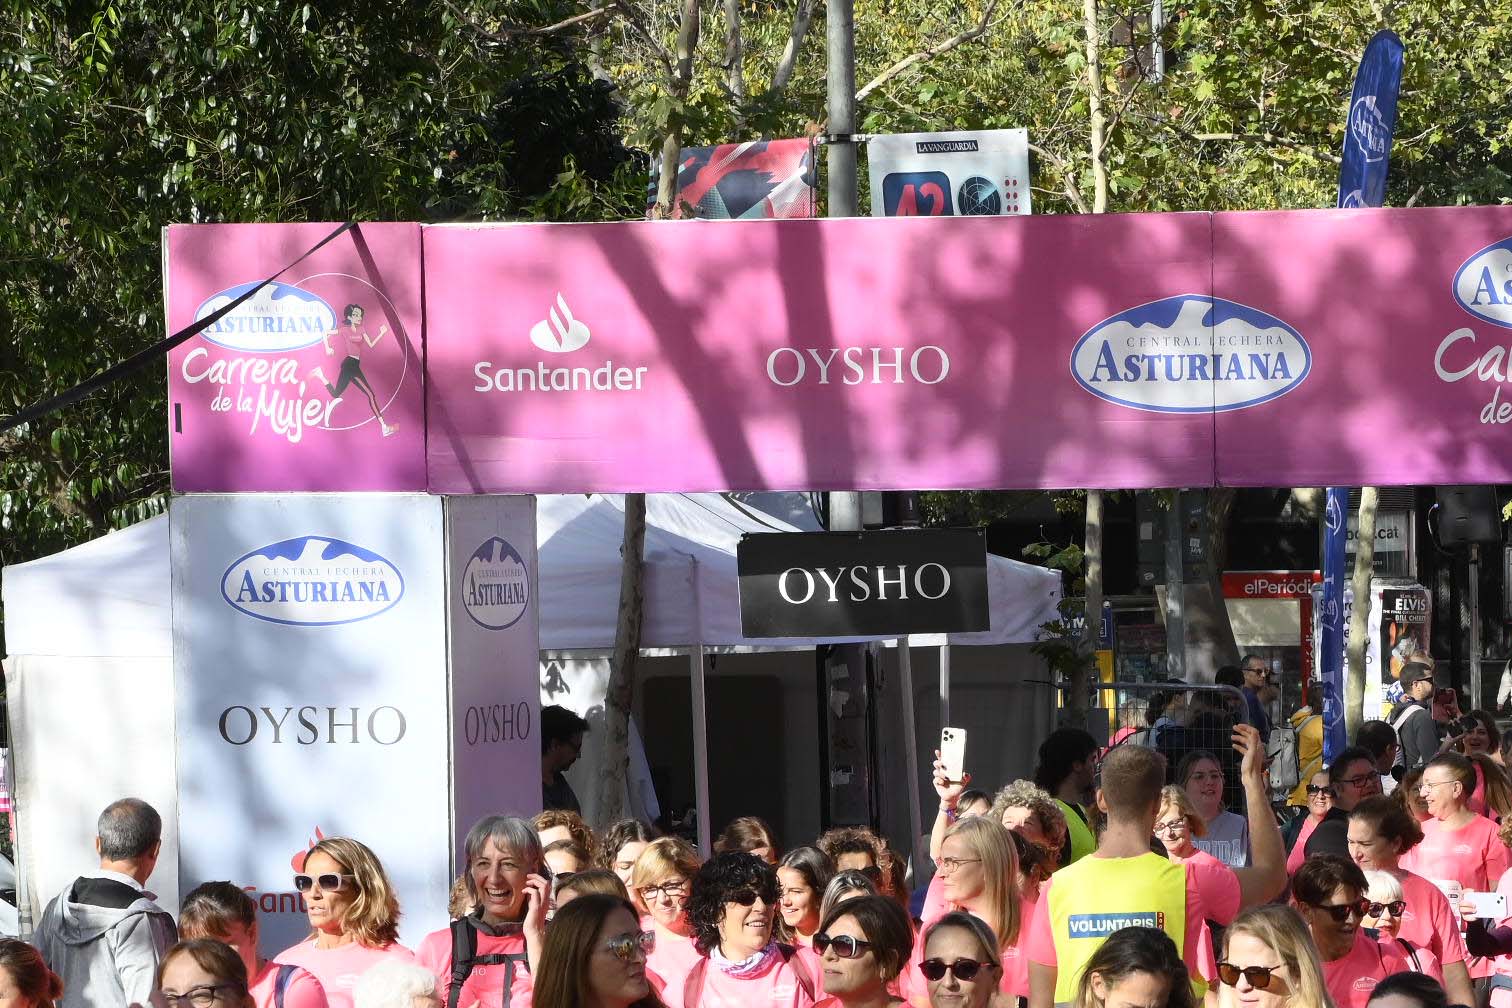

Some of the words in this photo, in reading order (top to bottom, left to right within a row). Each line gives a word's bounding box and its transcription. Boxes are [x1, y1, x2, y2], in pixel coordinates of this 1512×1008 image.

[1126, 336, 1200, 348] CENTRAL
[1210, 335, 1284, 345] LECHERA
[182, 347, 299, 385] Carrera
[474, 361, 647, 393] Santander
[766, 346, 950, 386] OYSHO
[1089, 340, 1293, 382] ASTURIANA
[211, 387, 232, 412] de
[237, 386, 253, 413] la
[250, 381, 343, 443] Mujer
[236, 569, 391, 603] ASTURIANA
[264, 567, 321, 577] CENTRAL
[327, 567, 385, 577] LECHERA
[467, 571, 525, 607] ASTURIANA
[778, 562, 951, 604] OYSHO
[1244, 577, 1315, 595] elPeriódi
[1395, 597, 1426, 611] ELVIS
[218, 705, 407, 745] OYSHO
[465, 701, 530, 746] OYSHO
[1069, 917, 1154, 933] VOLUNTARIS
